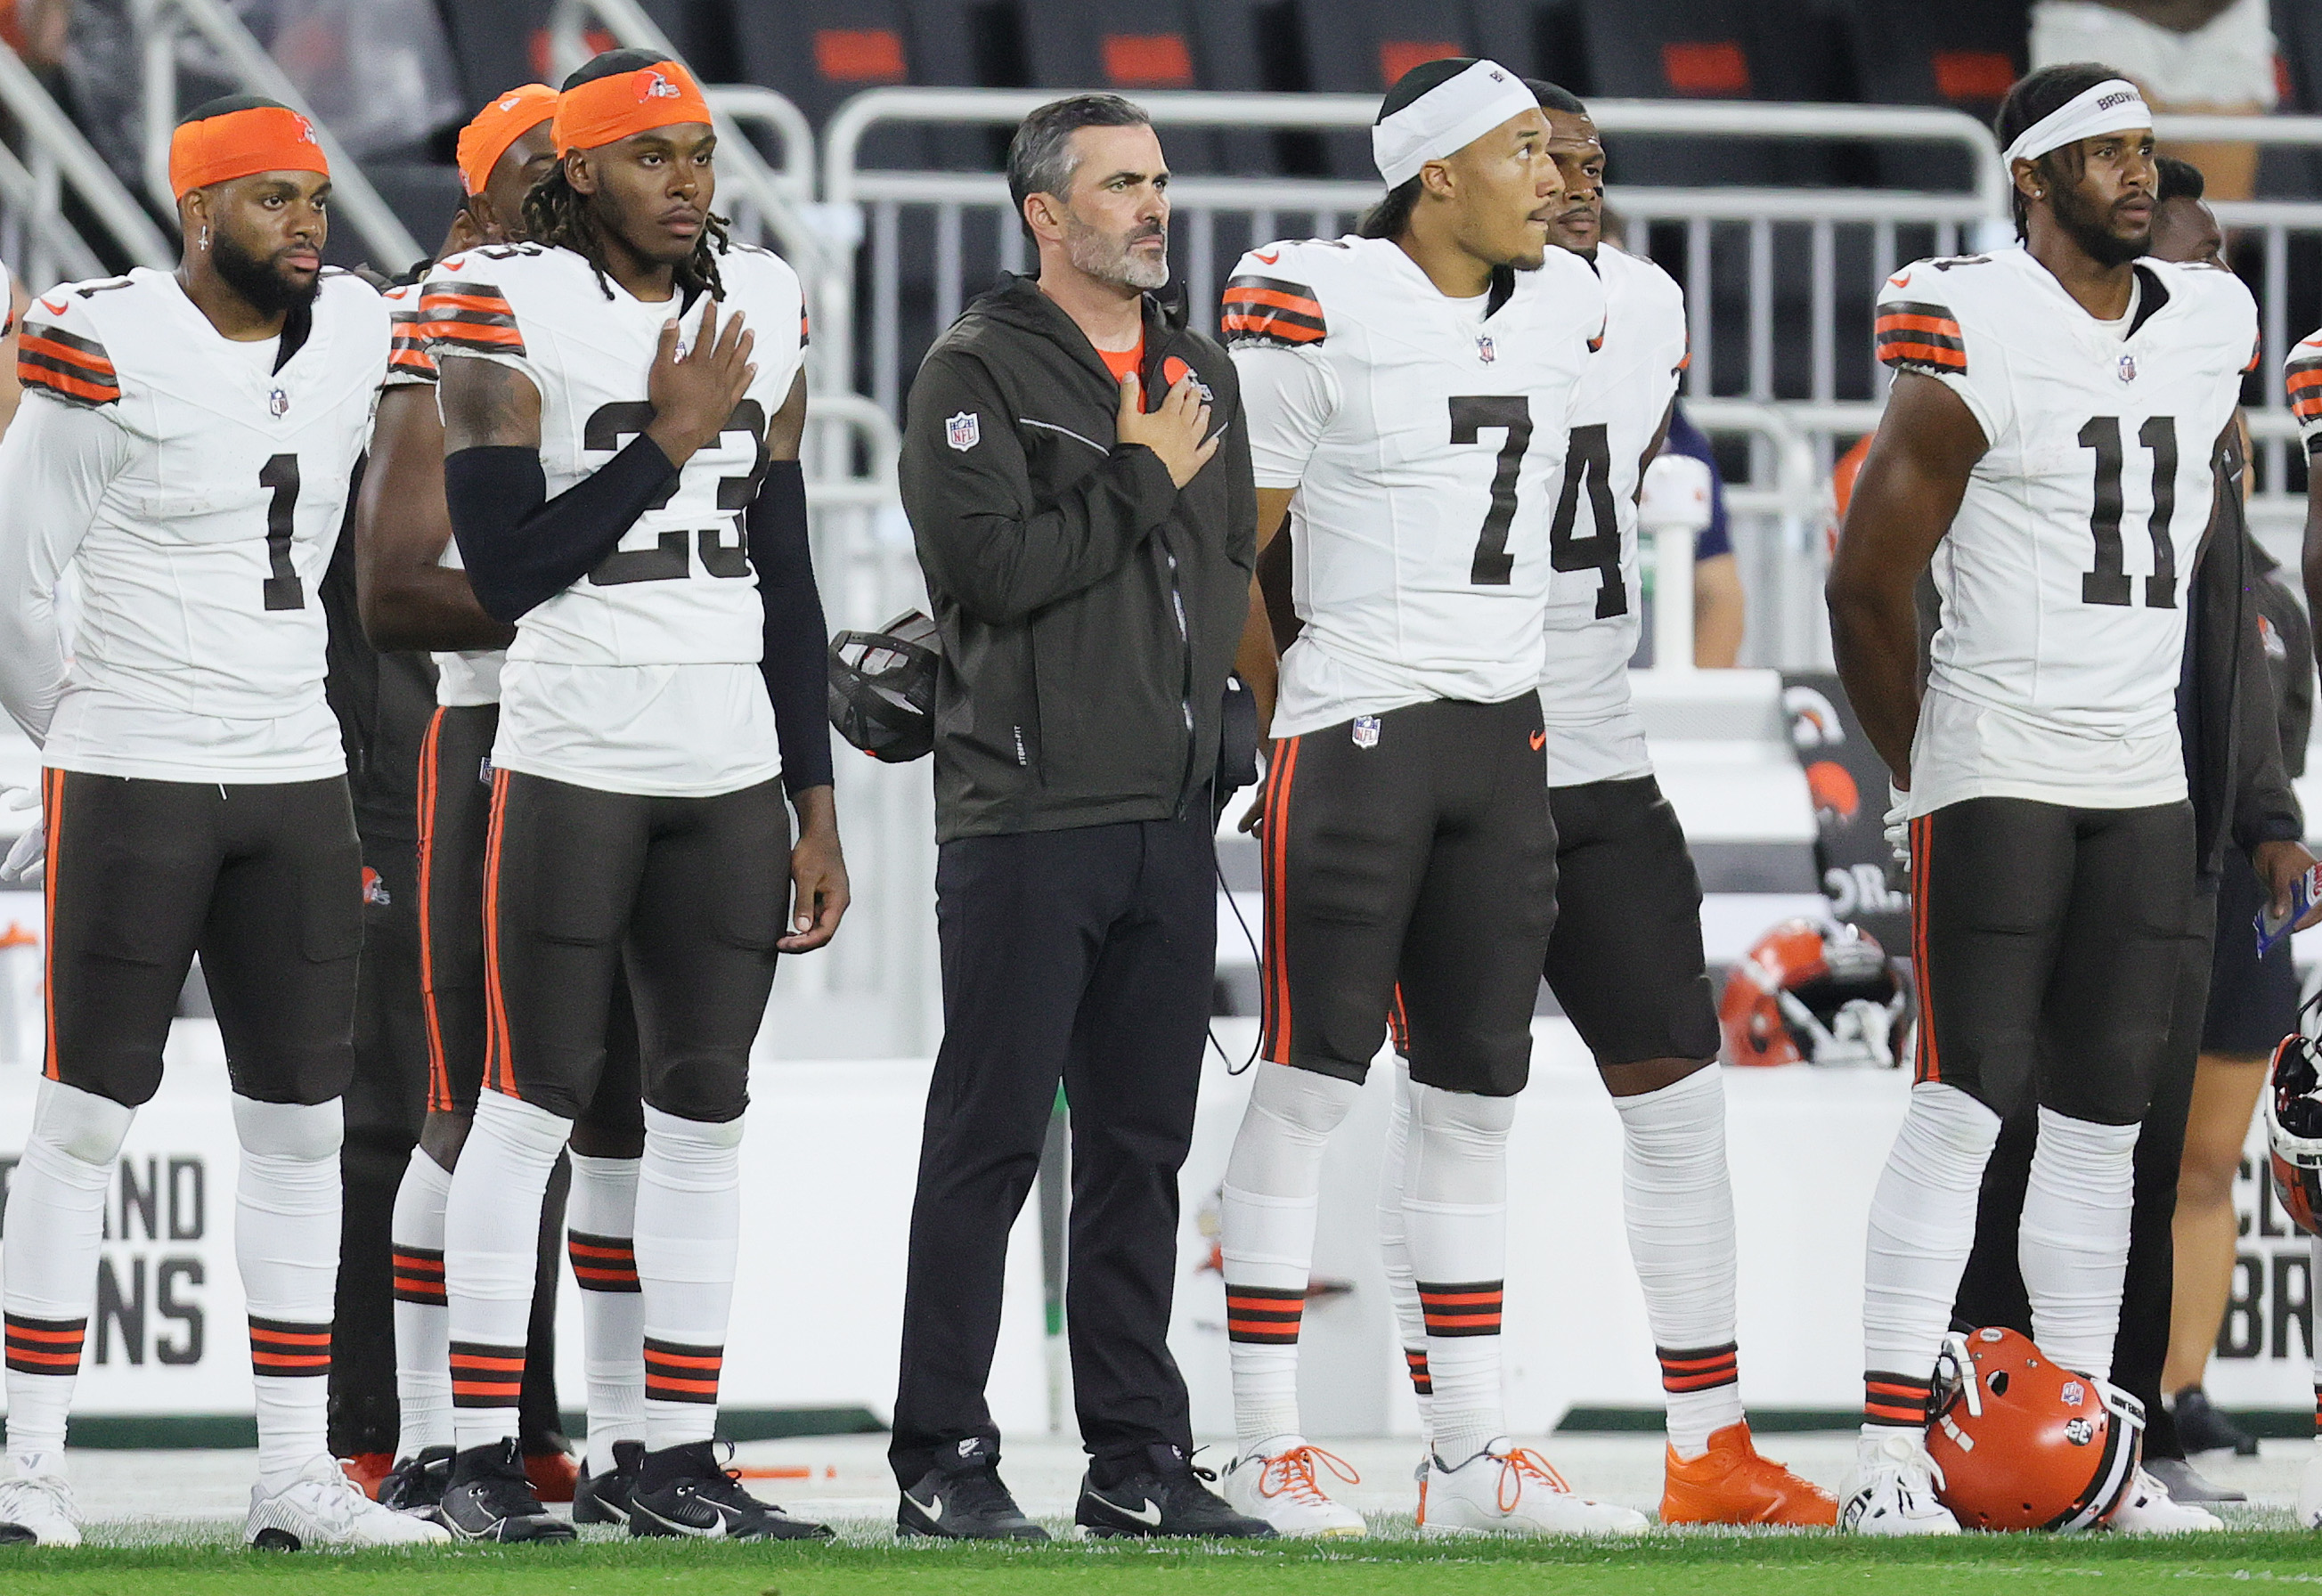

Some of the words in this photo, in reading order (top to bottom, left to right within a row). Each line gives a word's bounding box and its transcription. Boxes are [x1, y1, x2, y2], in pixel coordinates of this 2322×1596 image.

[583, 399, 770, 586] 23
[954, 428, 974, 443] NFL
[1448, 396, 1533, 585] 7
[1550, 423, 1627, 620] 4
[2078, 417, 2178, 608] 11
[259, 453, 305, 611] 1
